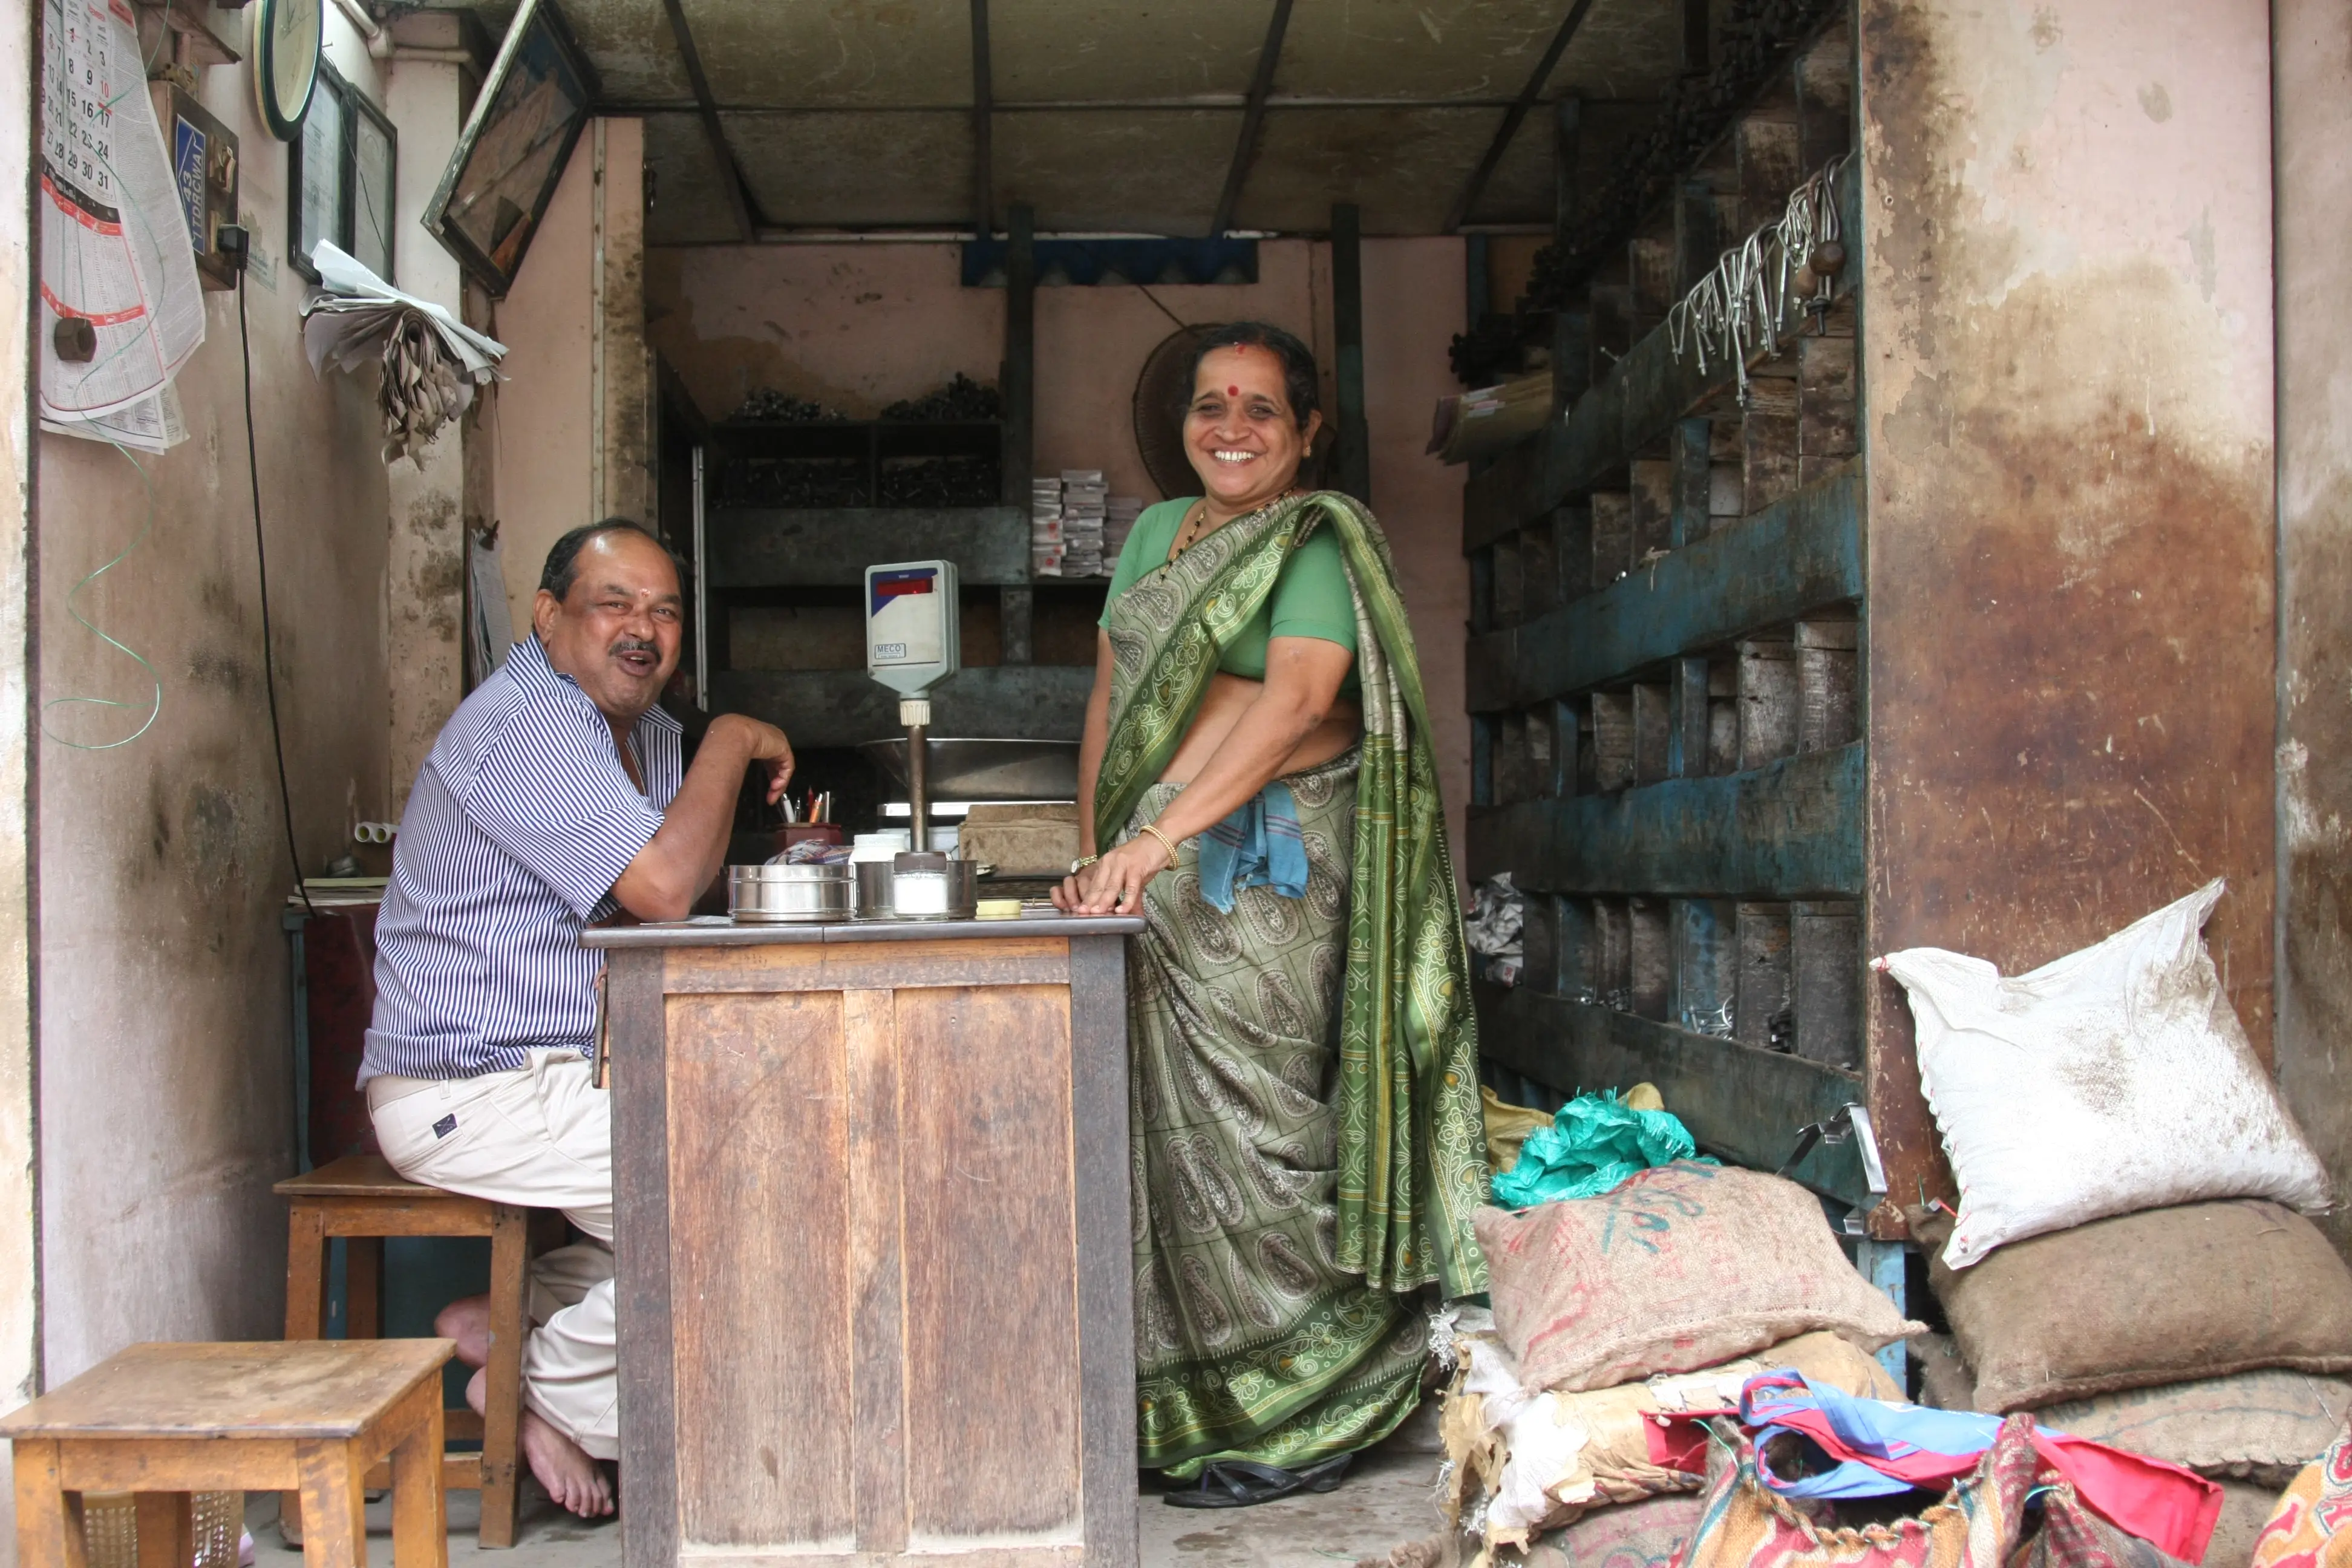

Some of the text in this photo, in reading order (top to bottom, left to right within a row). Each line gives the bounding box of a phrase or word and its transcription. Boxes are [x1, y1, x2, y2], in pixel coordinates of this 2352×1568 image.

[86, 39, 92, 56] 2
[99, 51, 105, 67] 3
[57, 45, 61, 61] 7
[68, 57, 74, 74] 8
[87, 69, 93, 85] 9
[100, 79, 110, 98] 10
[66, 88, 76, 108] 15
[82, 99, 94, 118] 16
[101, 109, 110, 128] 17
[54, 139, 64, 158] 28
[68, 150, 78, 169] 29
[82, 160, 93, 180] 30
[98, 171, 108, 190] 31
[98, 140, 109, 160] 24
[183, 170, 192, 202] 43
[877, 644, 901, 653] MECO
